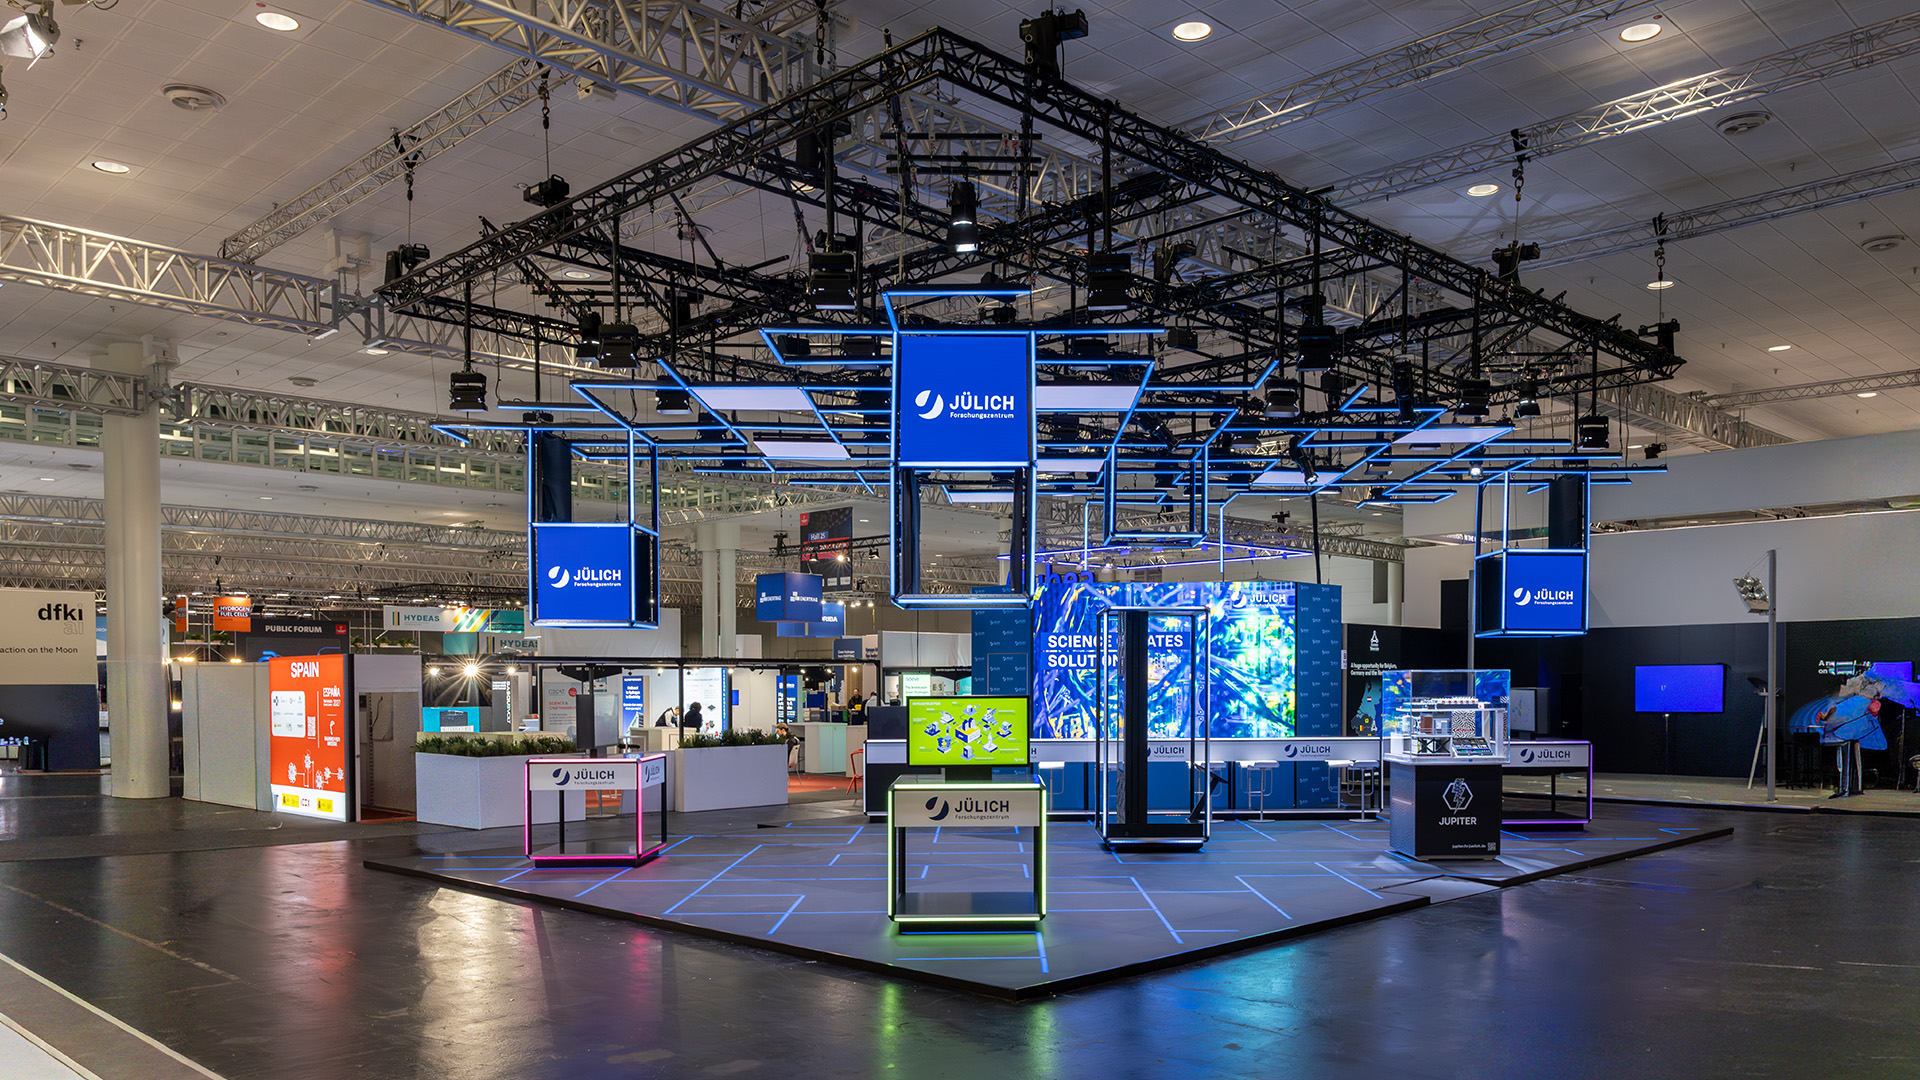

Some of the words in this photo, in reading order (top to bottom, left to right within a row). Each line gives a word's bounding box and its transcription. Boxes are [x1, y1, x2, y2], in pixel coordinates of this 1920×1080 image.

[949, 391, 1014, 410] JÜLICH
[573, 567, 621, 581] JÜLICH
[1249, 592, 1286, 603] JÜLICH
[1534, 588, 1573, 600] JÜLICH
[38, 603, 83, 620] dfki
[294, 625, 322, 633] FORUM
[1047, 635, 1112, 648] SCIENCE
[290, 661, 319, 678] SPAIN
[322, 685, 341, 698] ESPAÑA
[1154, 746, 1185, 754] JÜLICH
[1300, 744, 1331, 753] JÜLICH
[1537, 749, 1571, 759] JÜLICH
[574, 769, 615, 780] JÜLICH
[954, 797, 1009, 813] JÜLICH
[1438, 817, 1477, 826] JUPITER
